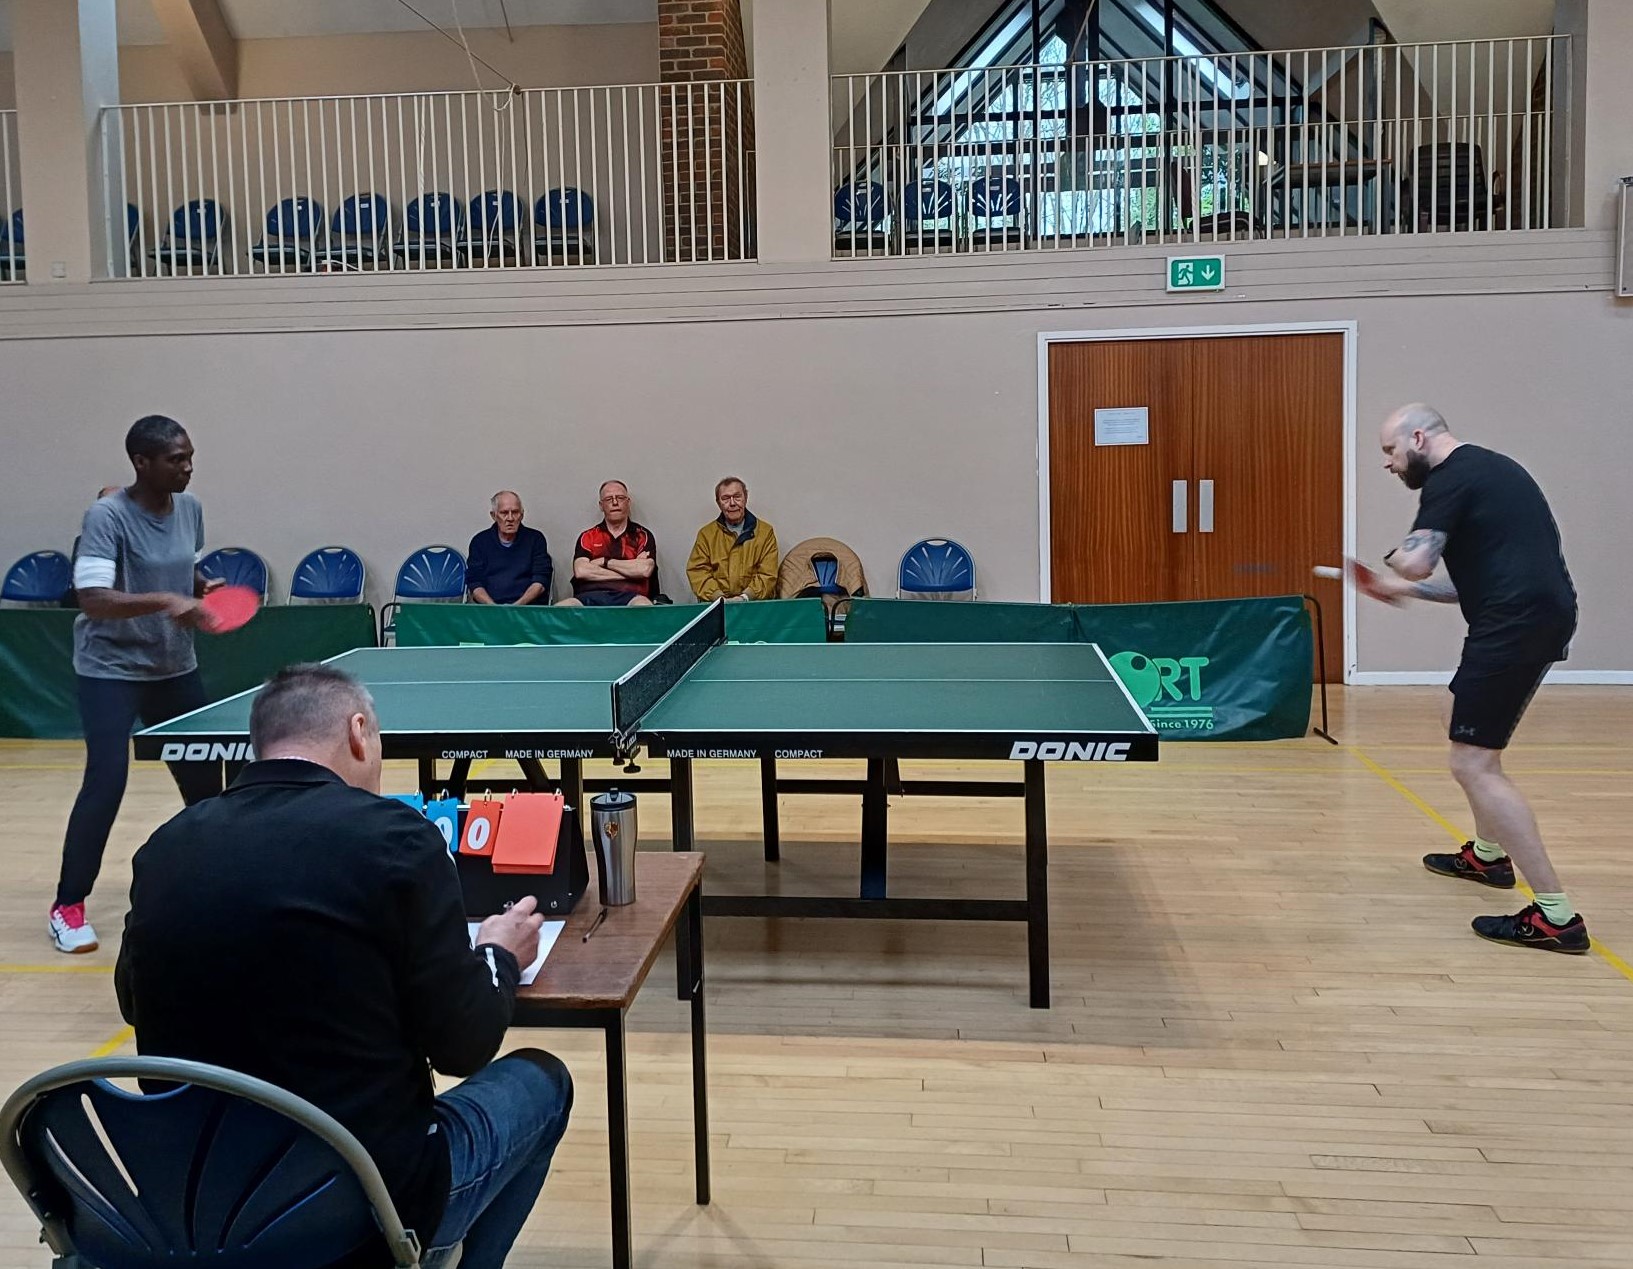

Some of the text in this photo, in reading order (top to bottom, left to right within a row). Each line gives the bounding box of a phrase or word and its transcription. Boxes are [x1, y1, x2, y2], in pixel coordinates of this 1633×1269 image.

[1184, 719, 1214, 730] 1976
[441, 750, 488, 759] COMPACT
[505, 749, 594, 759] MADE IN GERMANY
[666, 749, 757, 758] MADE IN GERMANY
[774, 749, 823, 759] COMPACT
[1009, 741, 1132, 761] DONIC
[467, 817, 490, 850] 0
